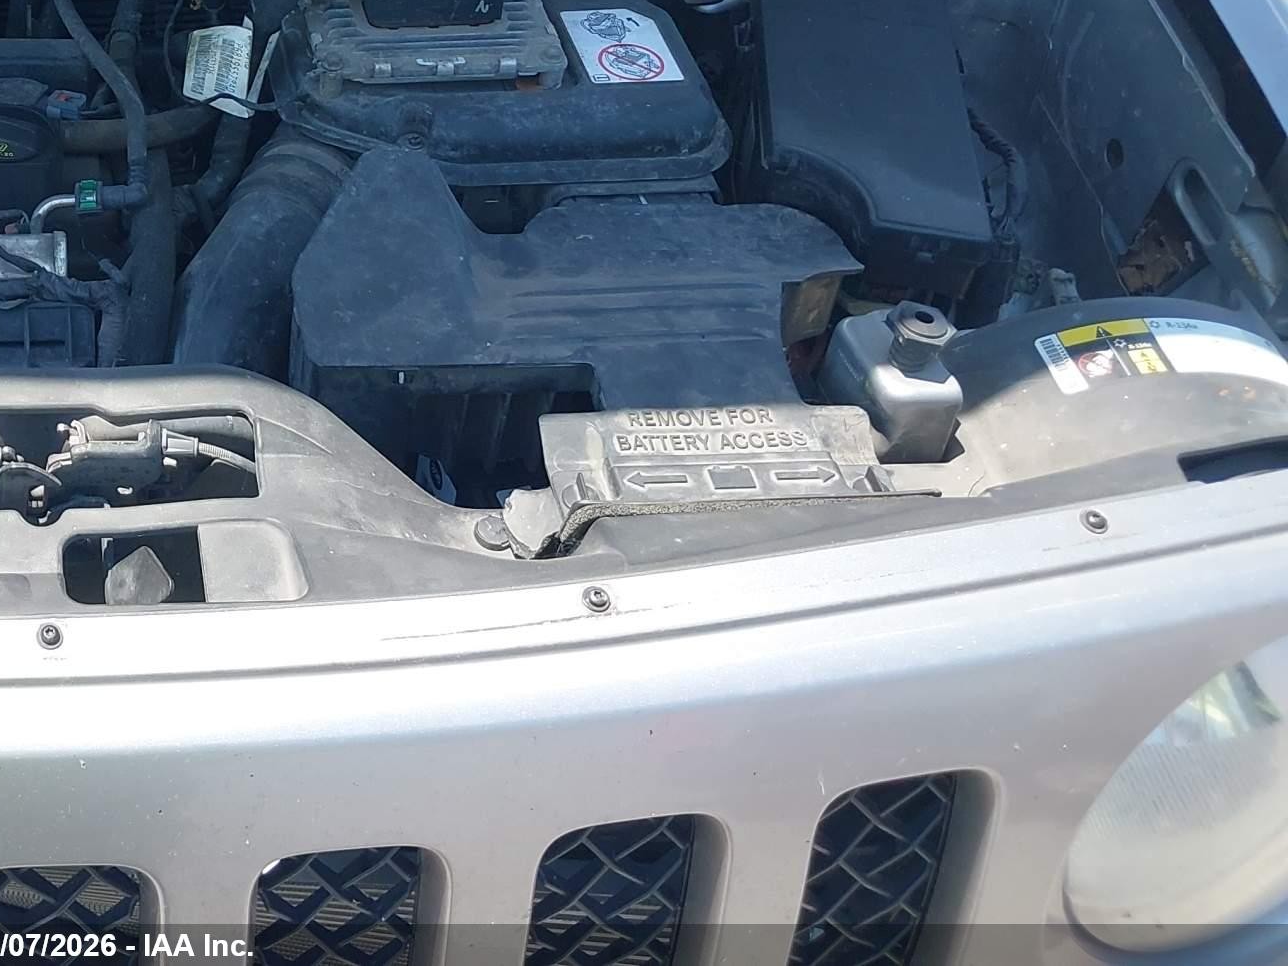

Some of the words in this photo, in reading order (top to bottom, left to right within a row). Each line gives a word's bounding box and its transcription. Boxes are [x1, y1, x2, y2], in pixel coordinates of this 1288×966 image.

[627, 409, 722, 427] REMOVE
[725, 408, 774, 425] FOR
[616, 434, 711, 452] BATTERY
[720, 431, 808, 450] ACCESS
